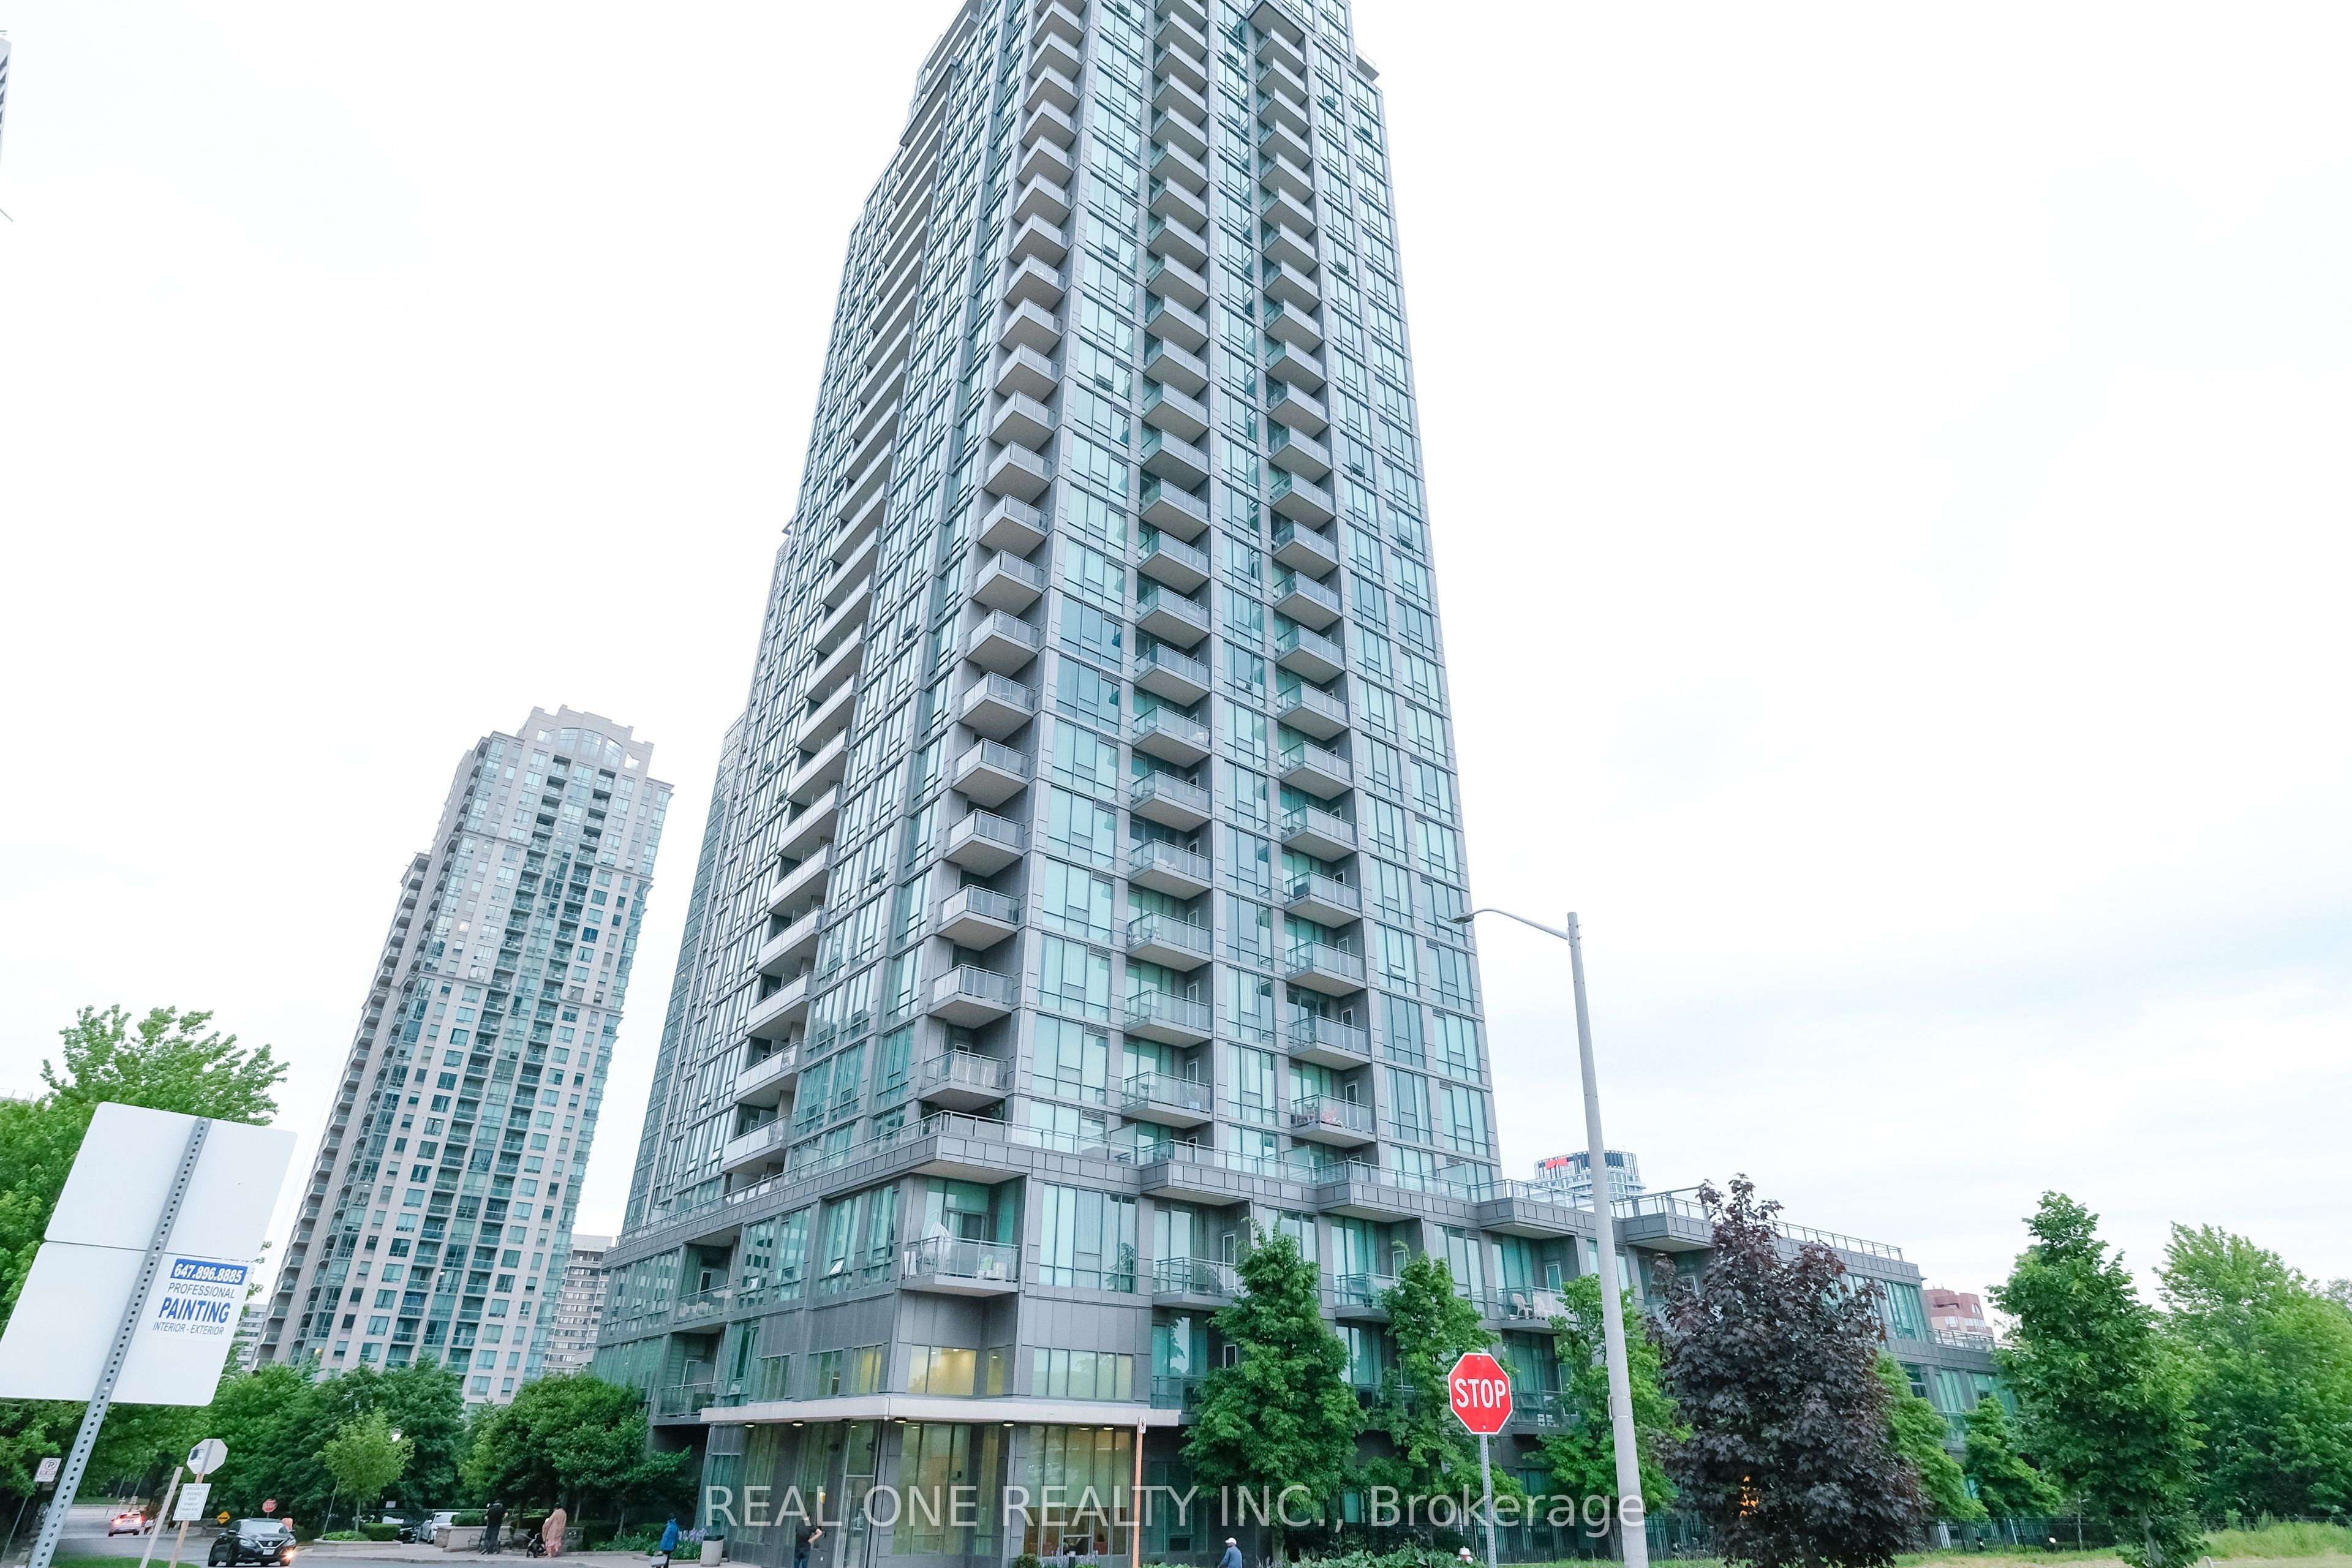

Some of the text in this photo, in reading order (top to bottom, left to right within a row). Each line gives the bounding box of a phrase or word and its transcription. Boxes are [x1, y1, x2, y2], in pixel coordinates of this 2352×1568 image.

[174, 1263, 244, 1283] 647.896.8885
[167, 1282, 235, 1298] PROFESSIONAL
[159, 1297, 231, 1324] PAINTING
[153, 1321, 186, 1333] INTERIOR
[190, 1324, 224, 1335] EXTERIOR
[1455, 1378, 1506, 1408] STOP
